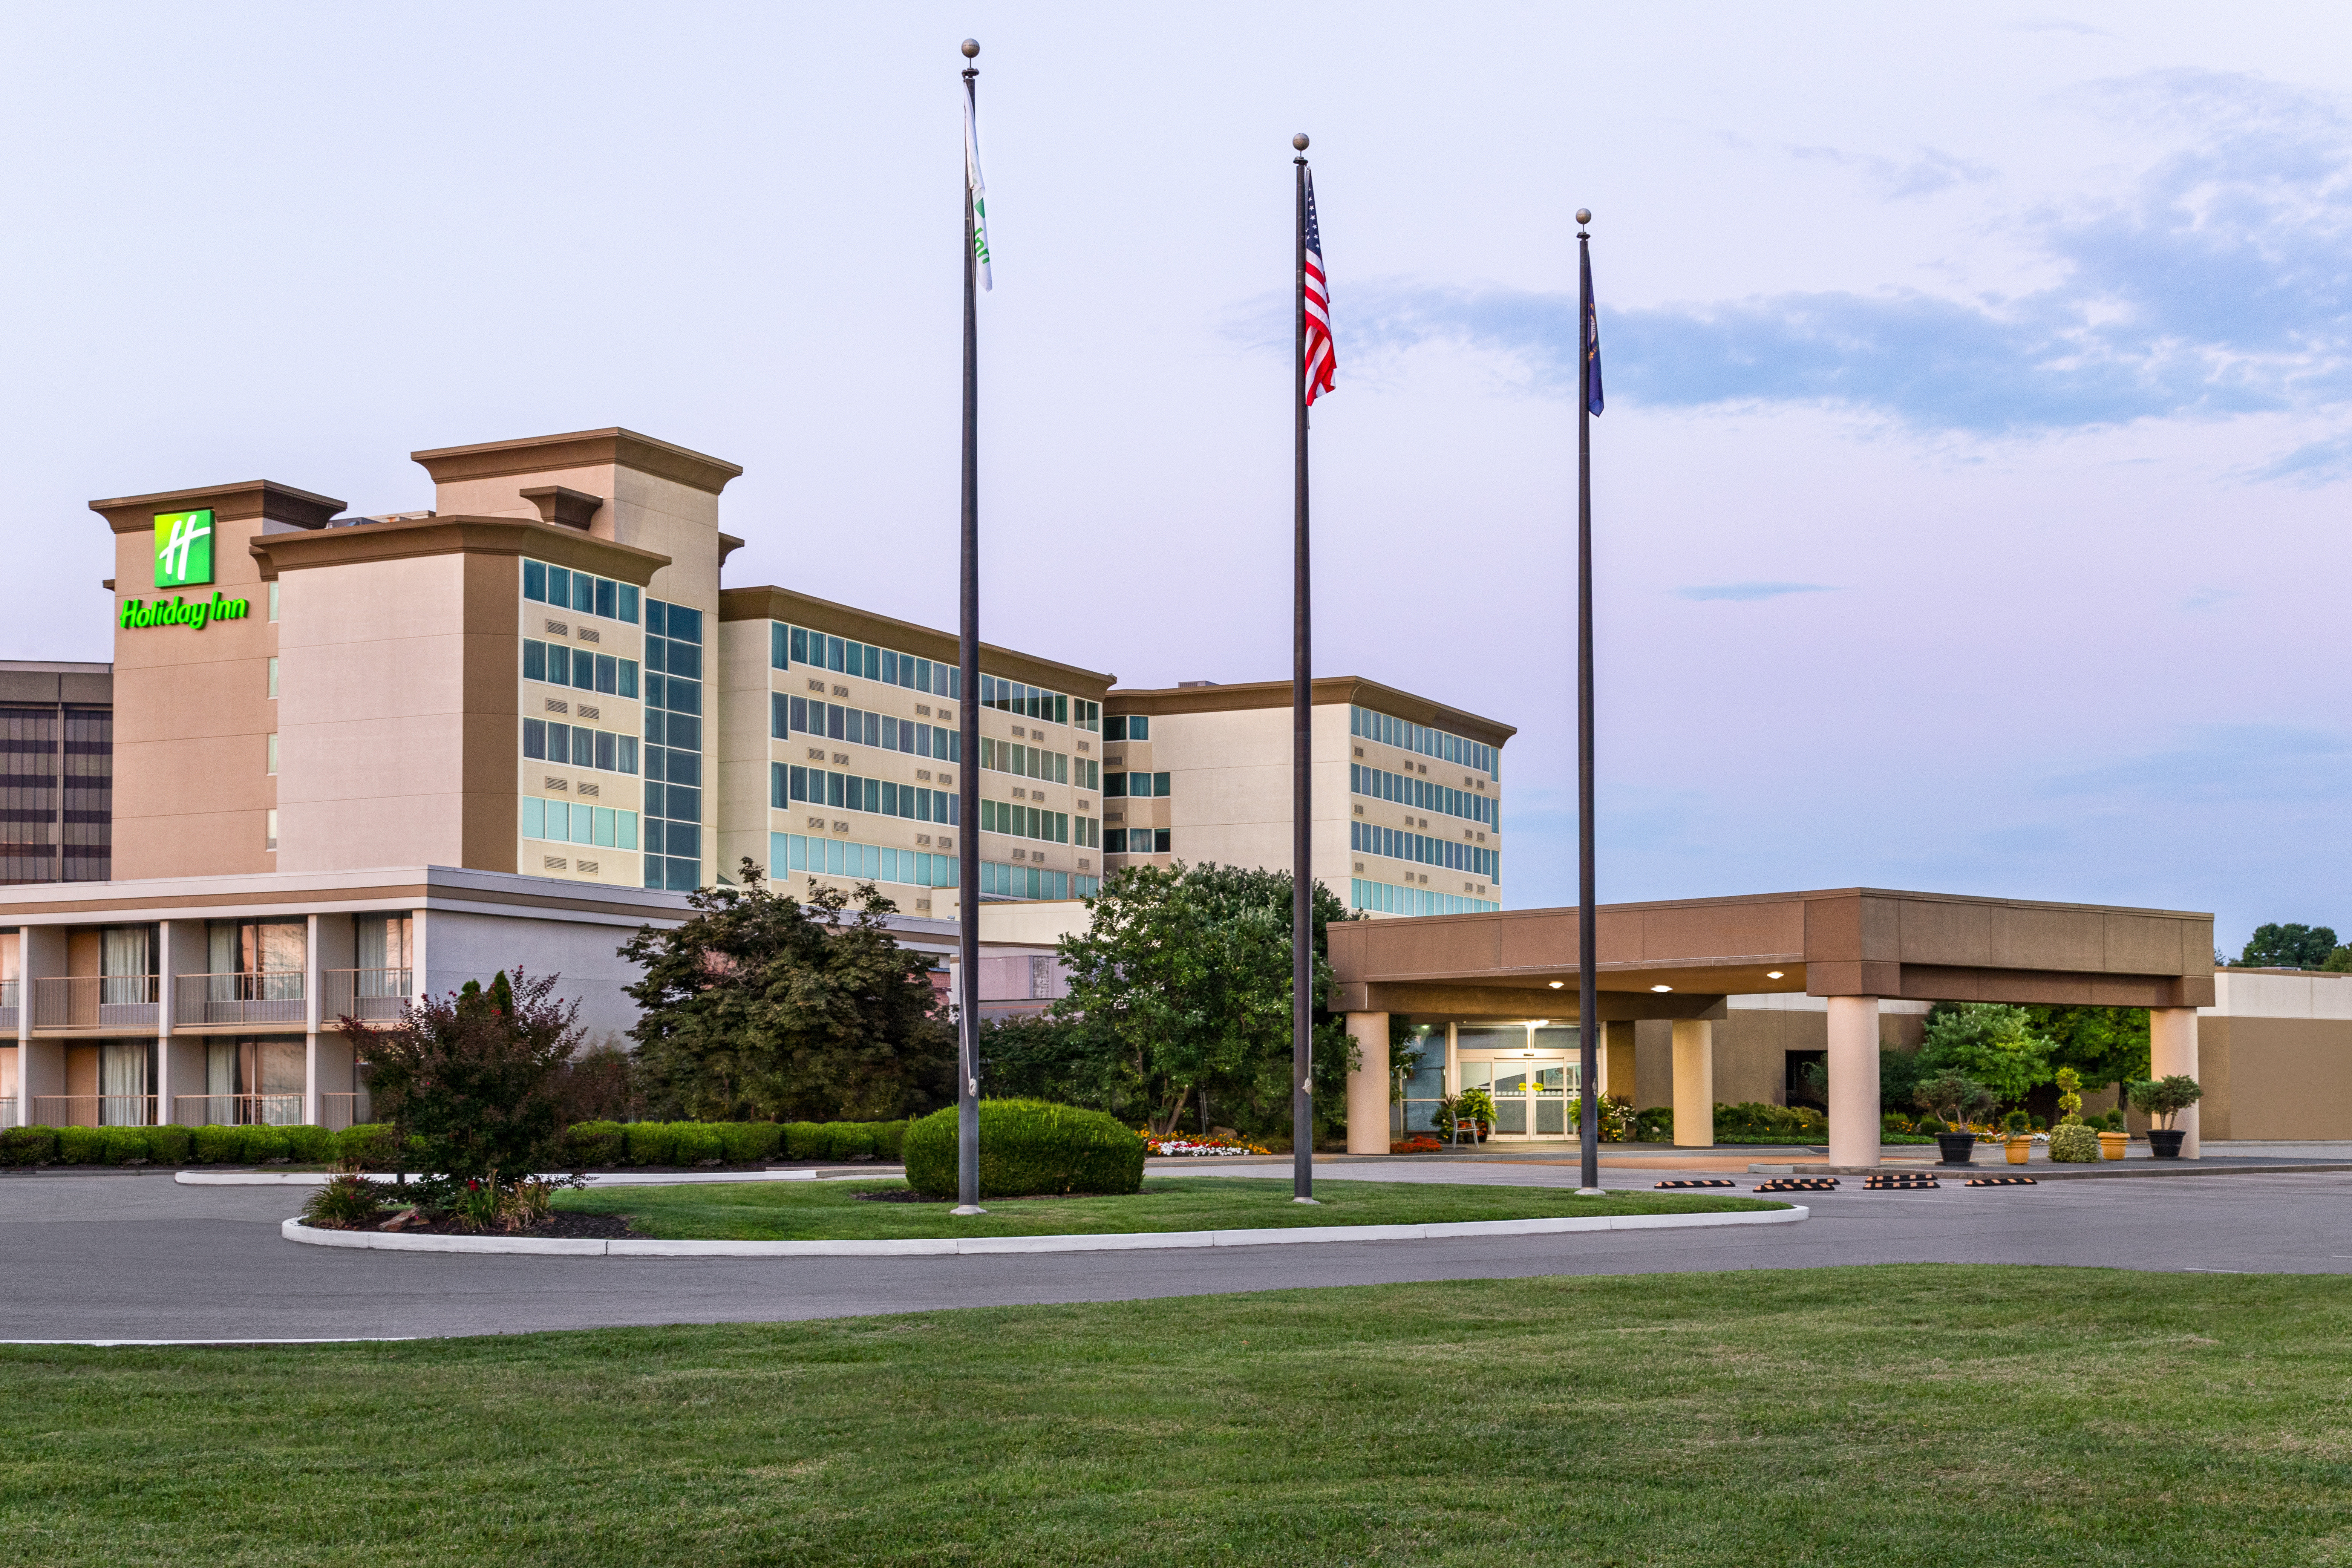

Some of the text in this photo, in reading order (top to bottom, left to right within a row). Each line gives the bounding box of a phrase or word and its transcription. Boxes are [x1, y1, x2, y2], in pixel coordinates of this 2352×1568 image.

[159, 514, 210, 580] H
[119, 591, 247, 629] Holiday Inn
